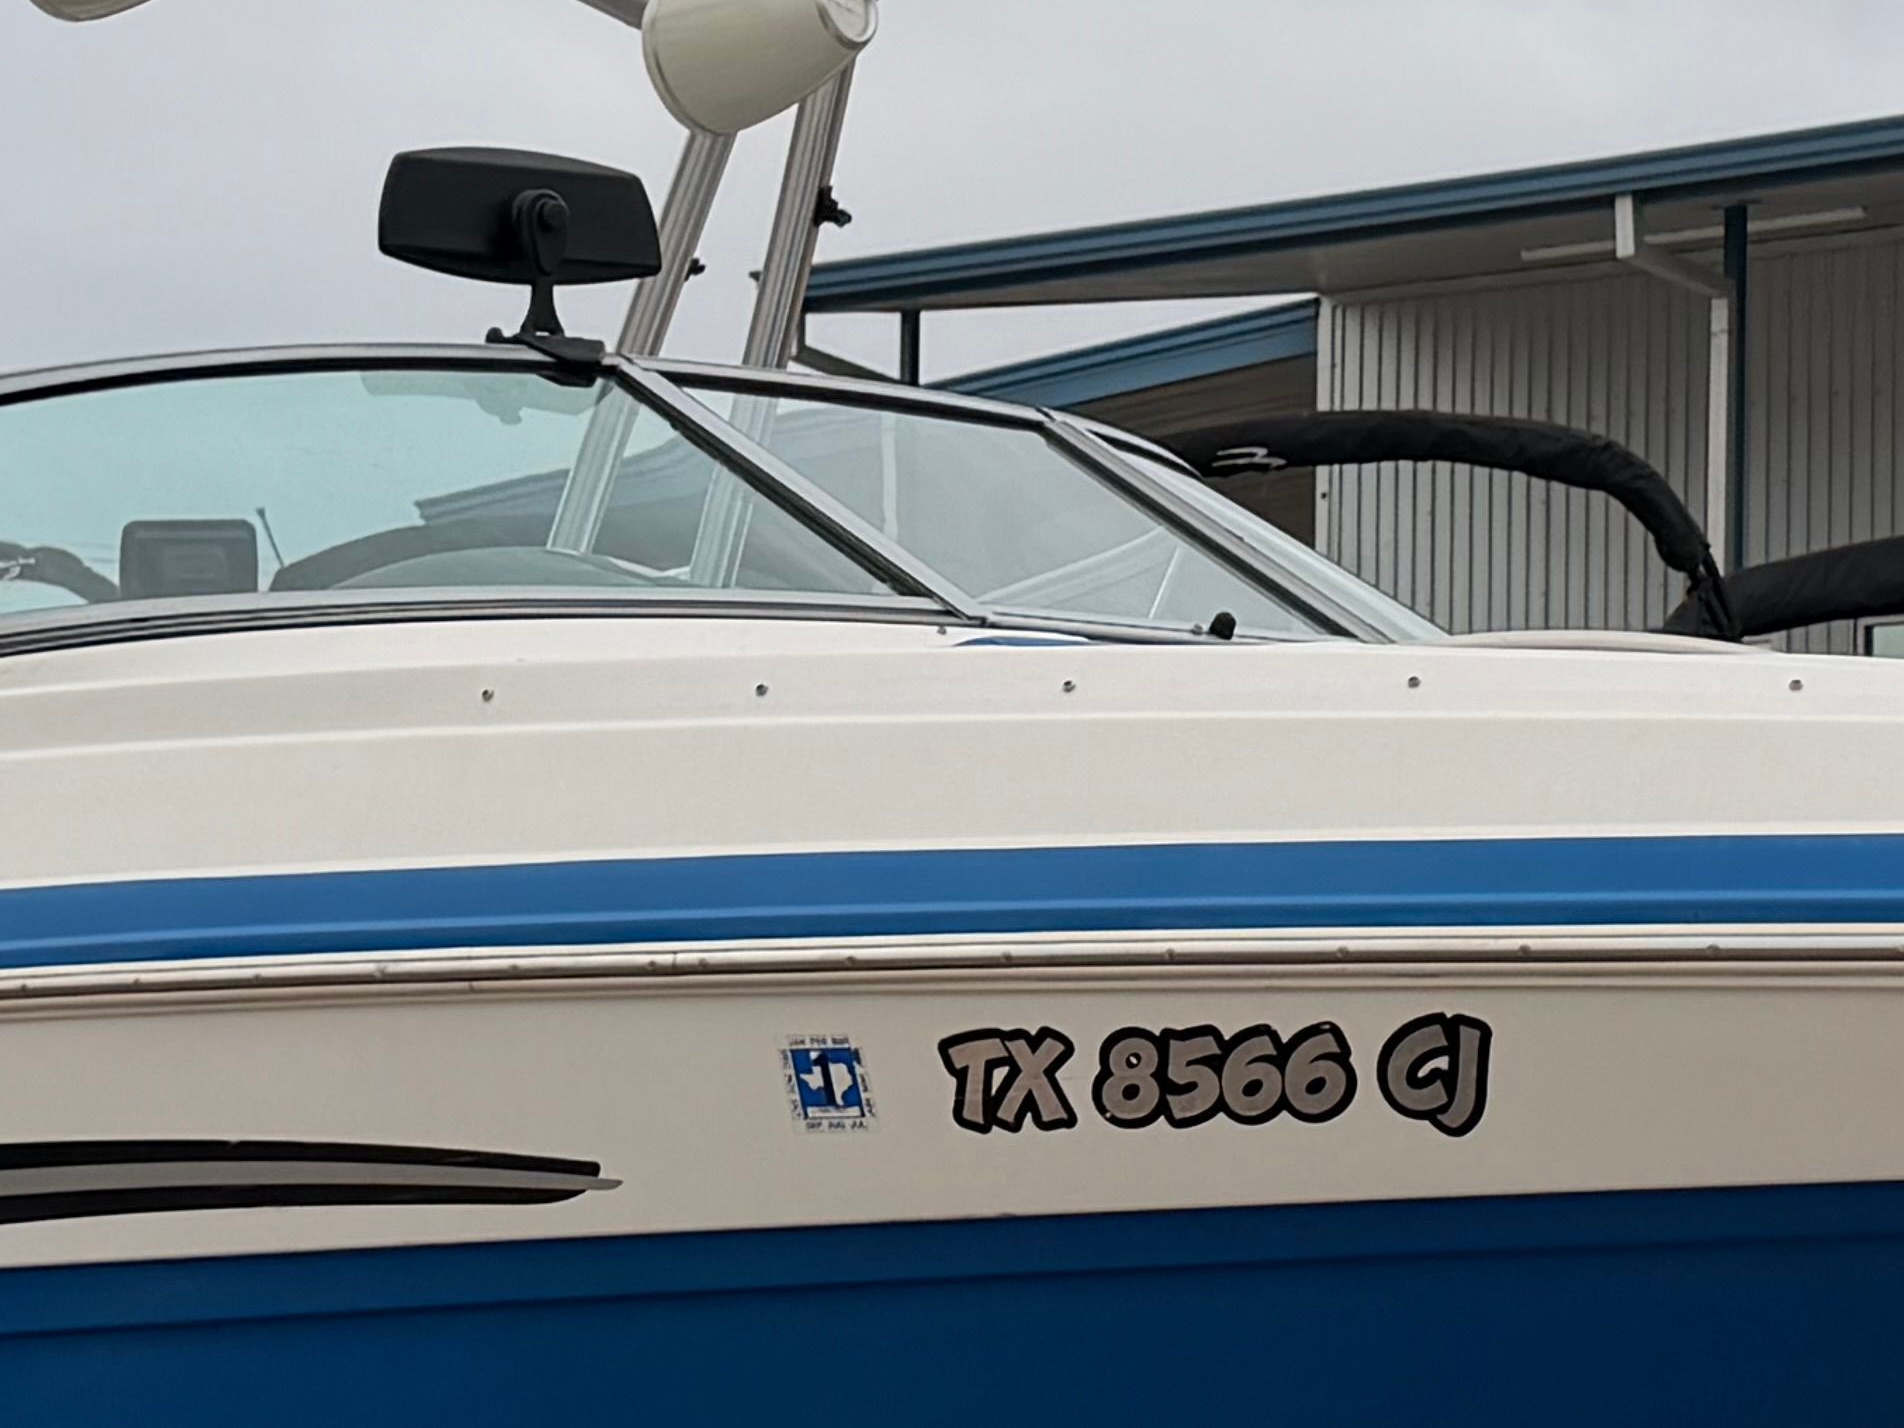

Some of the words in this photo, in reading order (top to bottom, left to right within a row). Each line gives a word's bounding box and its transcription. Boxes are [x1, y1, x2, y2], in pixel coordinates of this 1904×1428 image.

[938, 1026, 1077, 1134] TX
[1092, 1020, 1358, 1129] 8566
[1376, 1012, 1492, 1138] CJ
